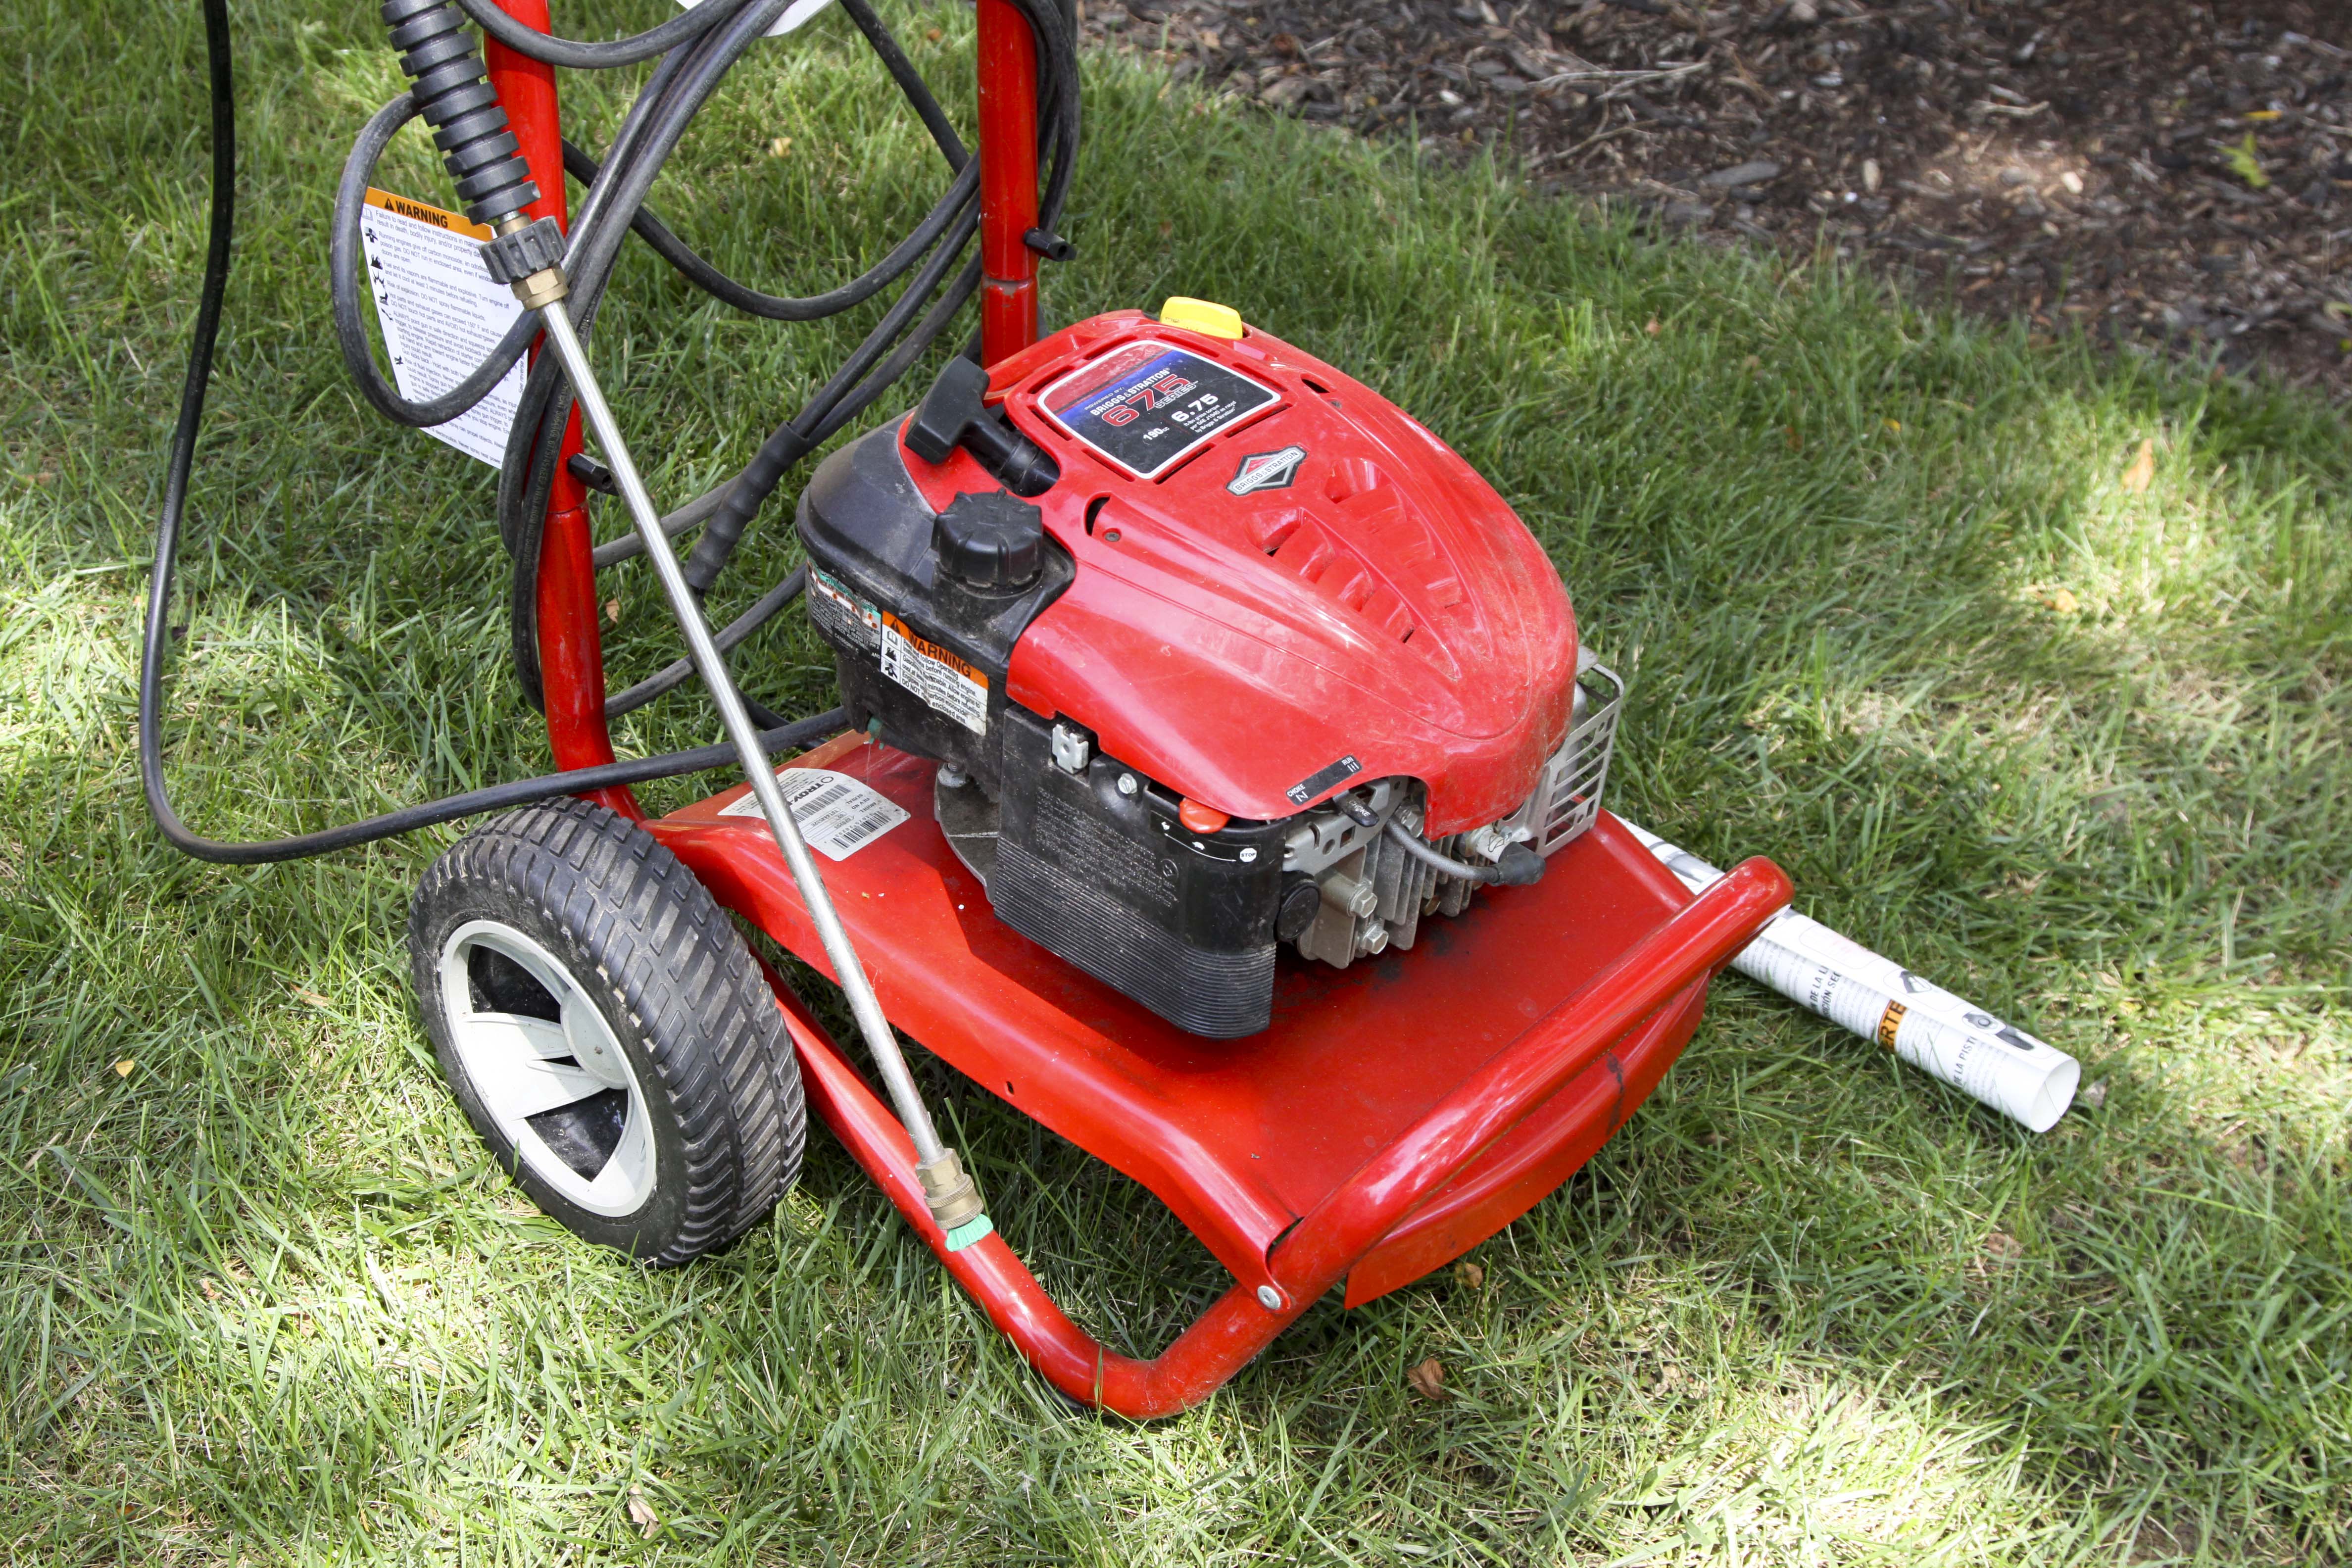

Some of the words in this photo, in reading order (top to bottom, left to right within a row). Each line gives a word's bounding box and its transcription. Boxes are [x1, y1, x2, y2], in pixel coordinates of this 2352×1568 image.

[395, 199, 449, 228] WARNING
[1102, 374, 1190, 426] 675
[1171, 393, 1219, 422] 6.75
[1206, 405, 1220, 413] torque
[1206, 410, 1220, 420] J1940
[1200, 421, 1215, 430] Briggs
[908, 630, 971, 677] WARNING
[921, 654, 935, 666] follow
[936, 661, 959, 680] Operating
[926, 665, 945, 675] before
[943, 672, 960, 688] running
[961, 684, 977, 697] engine.
[948, 685, 960, 696] Allow
[1342, 756, 1354, 766] RUN
[1287, 784, 1306, 797] CHOKE
[860, 802, 876, 812] MODEL
[1349, 800, 1371, 817] CHOKE
[1813, 976, 1824, 988] LA
[1811, 989, 1818, 1002] DE
